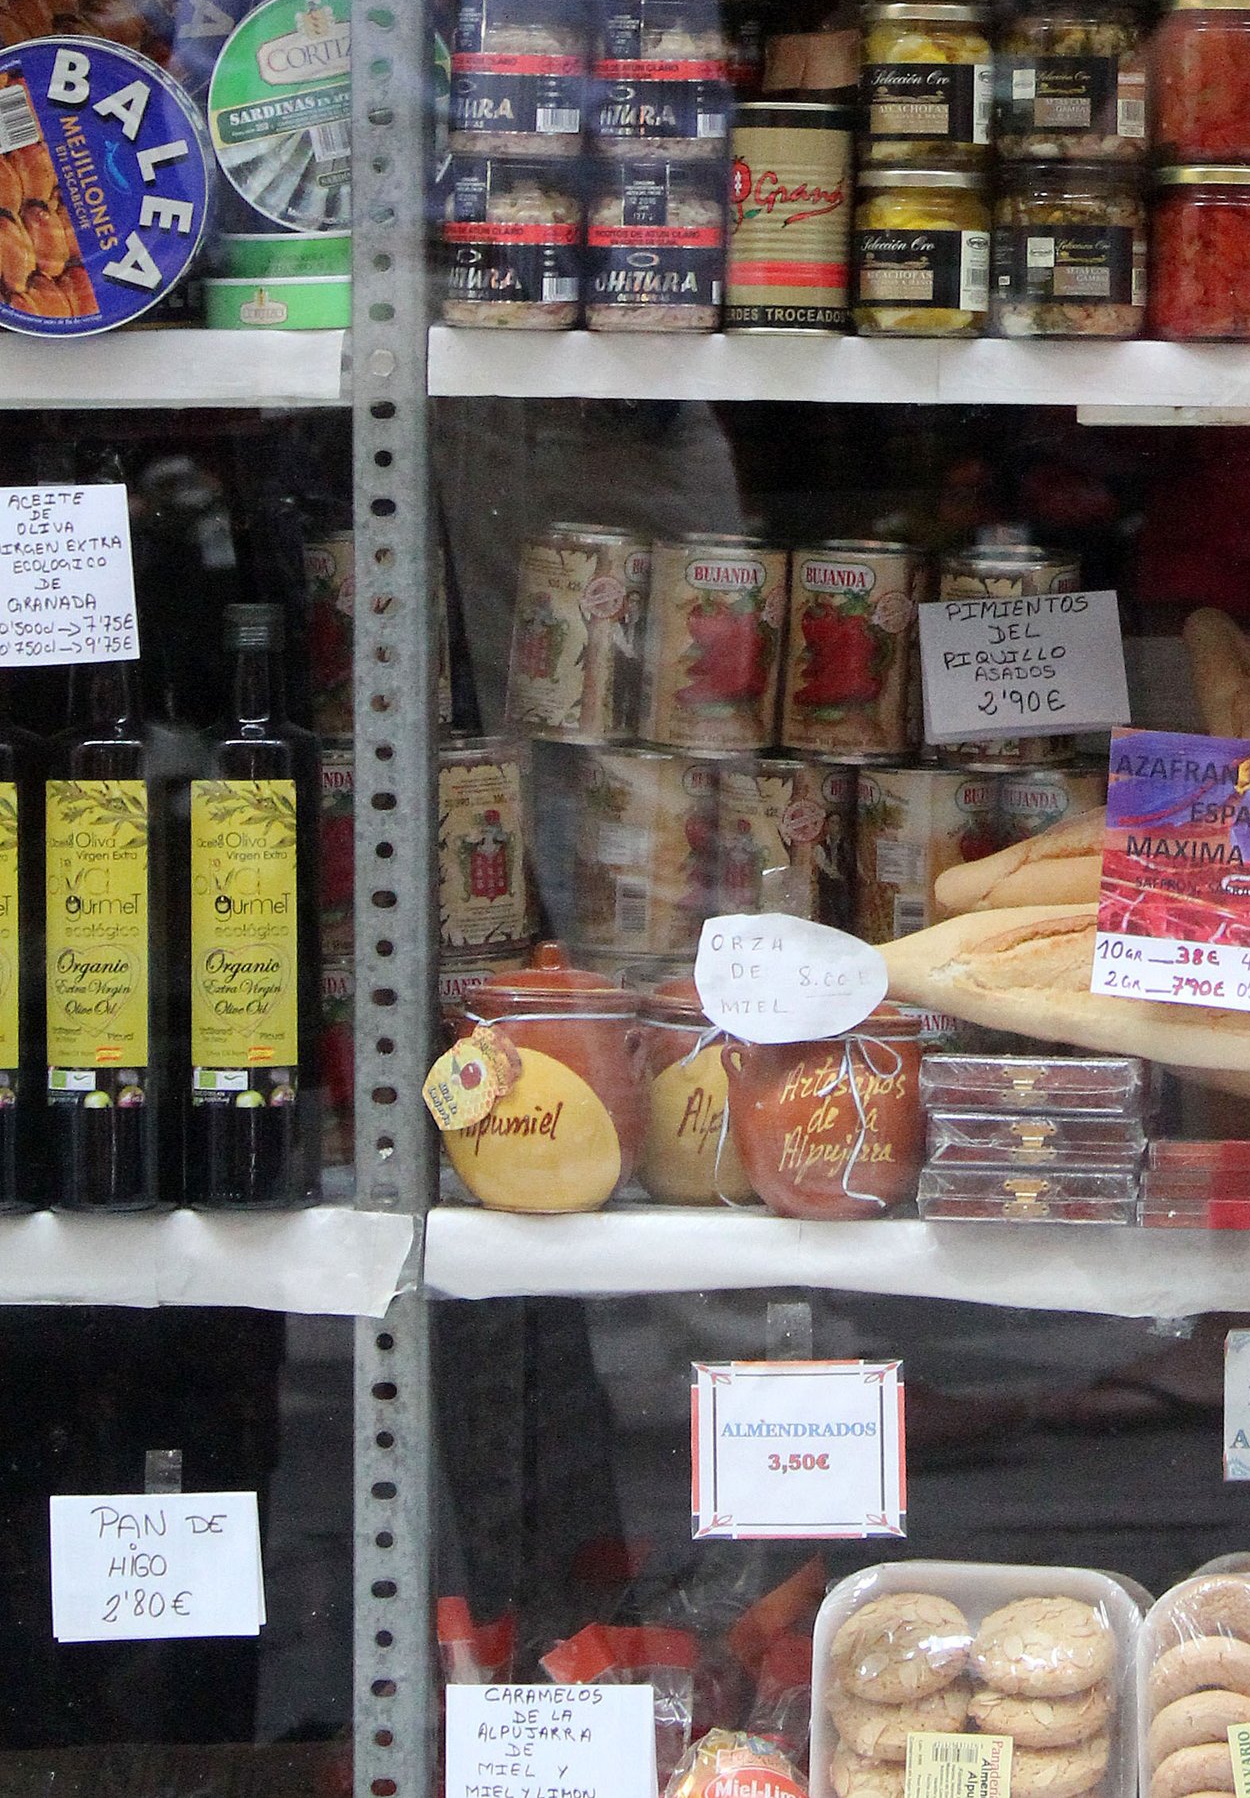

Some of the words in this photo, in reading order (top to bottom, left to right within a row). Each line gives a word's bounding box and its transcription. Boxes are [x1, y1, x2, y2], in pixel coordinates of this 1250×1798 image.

[871, 69, 922, 85] Selección
[926, 72, 949, 85] Oro
[228, 92, 316, 129] SARDINAS
[46, 48, 193, 292] BALEA
[58, 114, 119, 252] MEJILLONES
[860, 235, 906, 252] Selección
[910, 237, 935, 250] Oro
[8, 492, 84, 510] ACEITE
[17, 521, 74, 535] OLIVA
[66, 535, 122, 552] EXTRA
[13, 557, 107, 574] ECOLOGICO
[693, 566, 760, 585] BUJANDA
[806, 567, 868, 588] BUJANDA
[945, 595, 1088, 621] PIMIENTOS
[944, 646, 1066, 670] PIQUILLO
[1116, 755, 1239, 785] AZAFRAN
[75, 831, 116, 849] Oliva
[226, 831, 267, 849] Oliva
[1127, 835, 1244, 867] MAXIMA
[710, 933, 783, 952] ORZA
[57, 948, 129, 982] Organic
[205, 947, 280, 983] Organic
[721, 1422, 876, 1438] ALMENDRADOS
[768, 1454, 830, 1474] 3,50€
[91, 1506, 165, 1538] PAN
[484, 1687, 603, 1704] CARAMELOS
[478, 1724, 592, 1742] ALPUJARRA
[478, 1763, 535, 1777] MIEL
